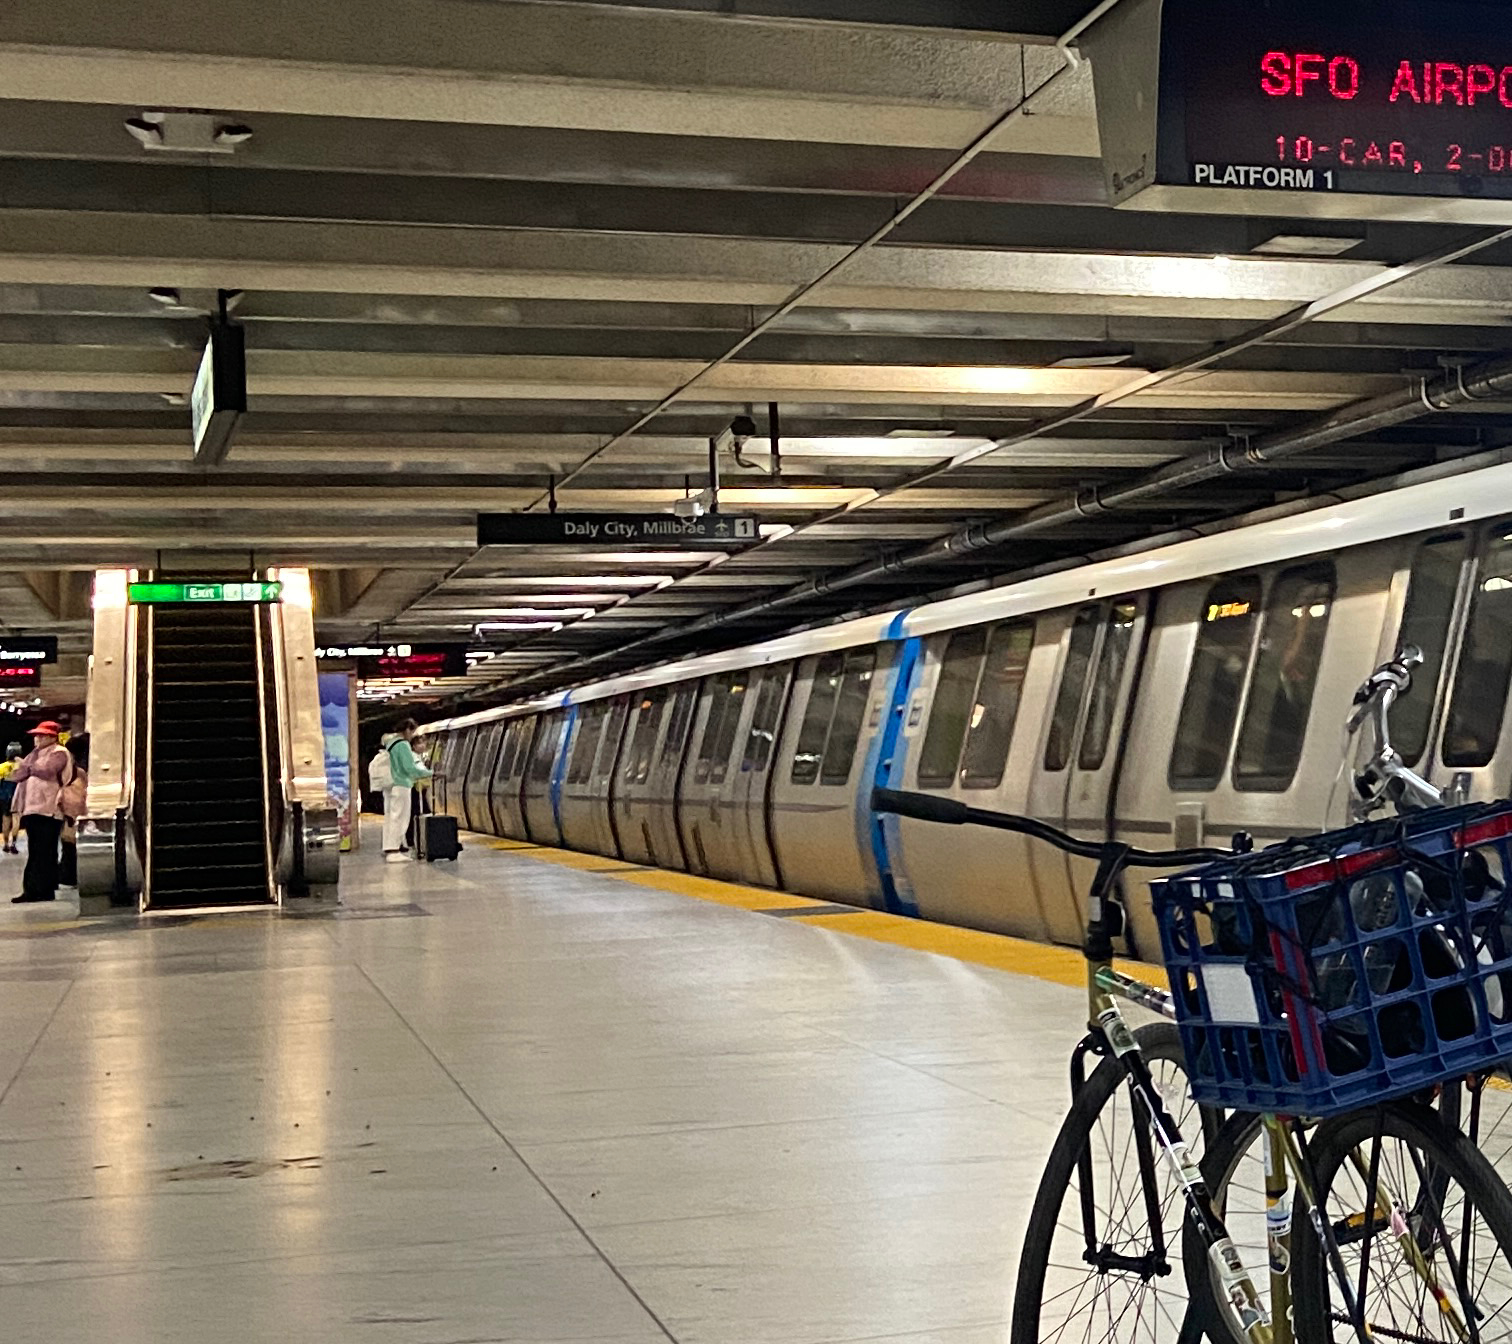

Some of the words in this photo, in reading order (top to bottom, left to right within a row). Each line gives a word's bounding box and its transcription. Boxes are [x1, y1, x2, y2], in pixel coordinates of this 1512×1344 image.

[1261, 51, 1360, 100] SFO
[1195, 164, 1314, 189] PLATFORM
[1323, 170, 1333, 189] 1
[564, 521, 599, 538] Daly
[604, 521, 638, 538] City,
[643, 521, 706, 535] Millbrae
[741, 520, 748, 535] 1
[189, 587, 215, 598] Exit
